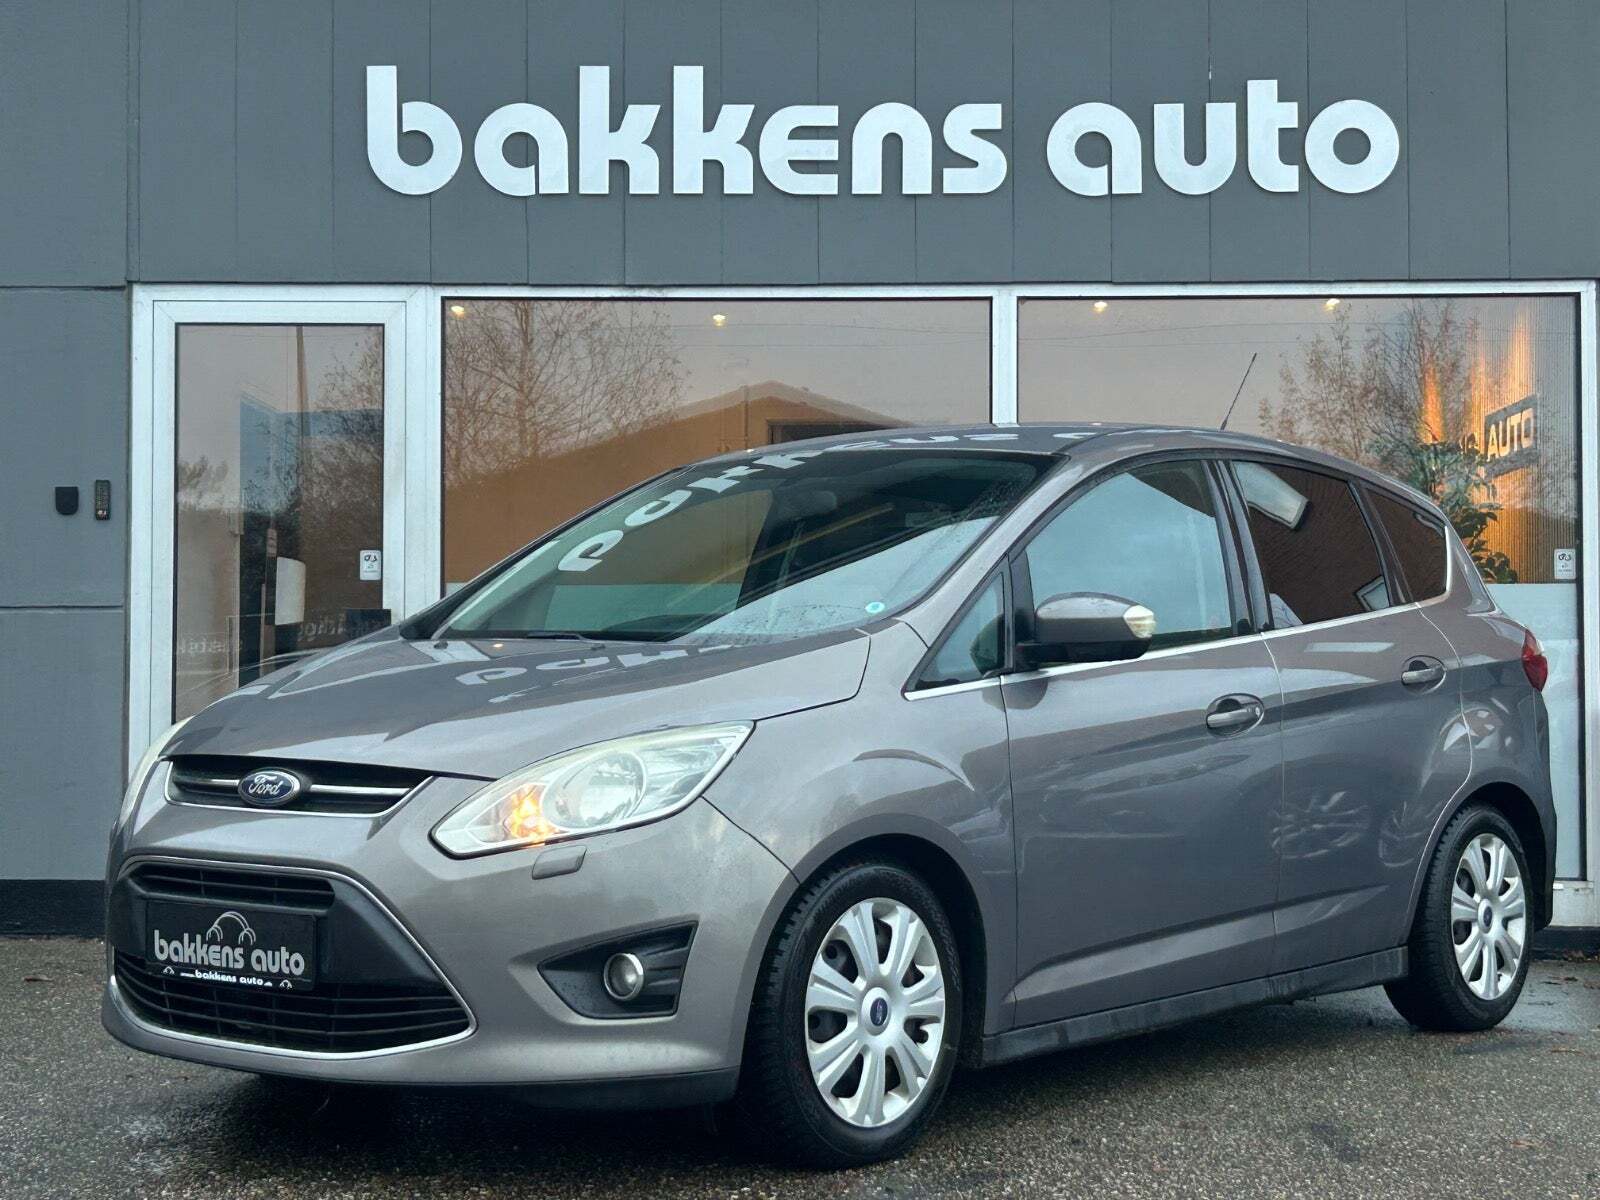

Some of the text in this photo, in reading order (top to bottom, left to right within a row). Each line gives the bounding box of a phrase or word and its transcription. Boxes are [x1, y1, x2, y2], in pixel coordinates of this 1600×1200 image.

[366, 65, 1400, 196] bakkens auto
[1487, 408, 1534, 462] AUTO
[248, 774, 284, 795] Ford
[153, 929, 305, 976] bakkens auto
[194, 969, 264, 986] bakkens auto
